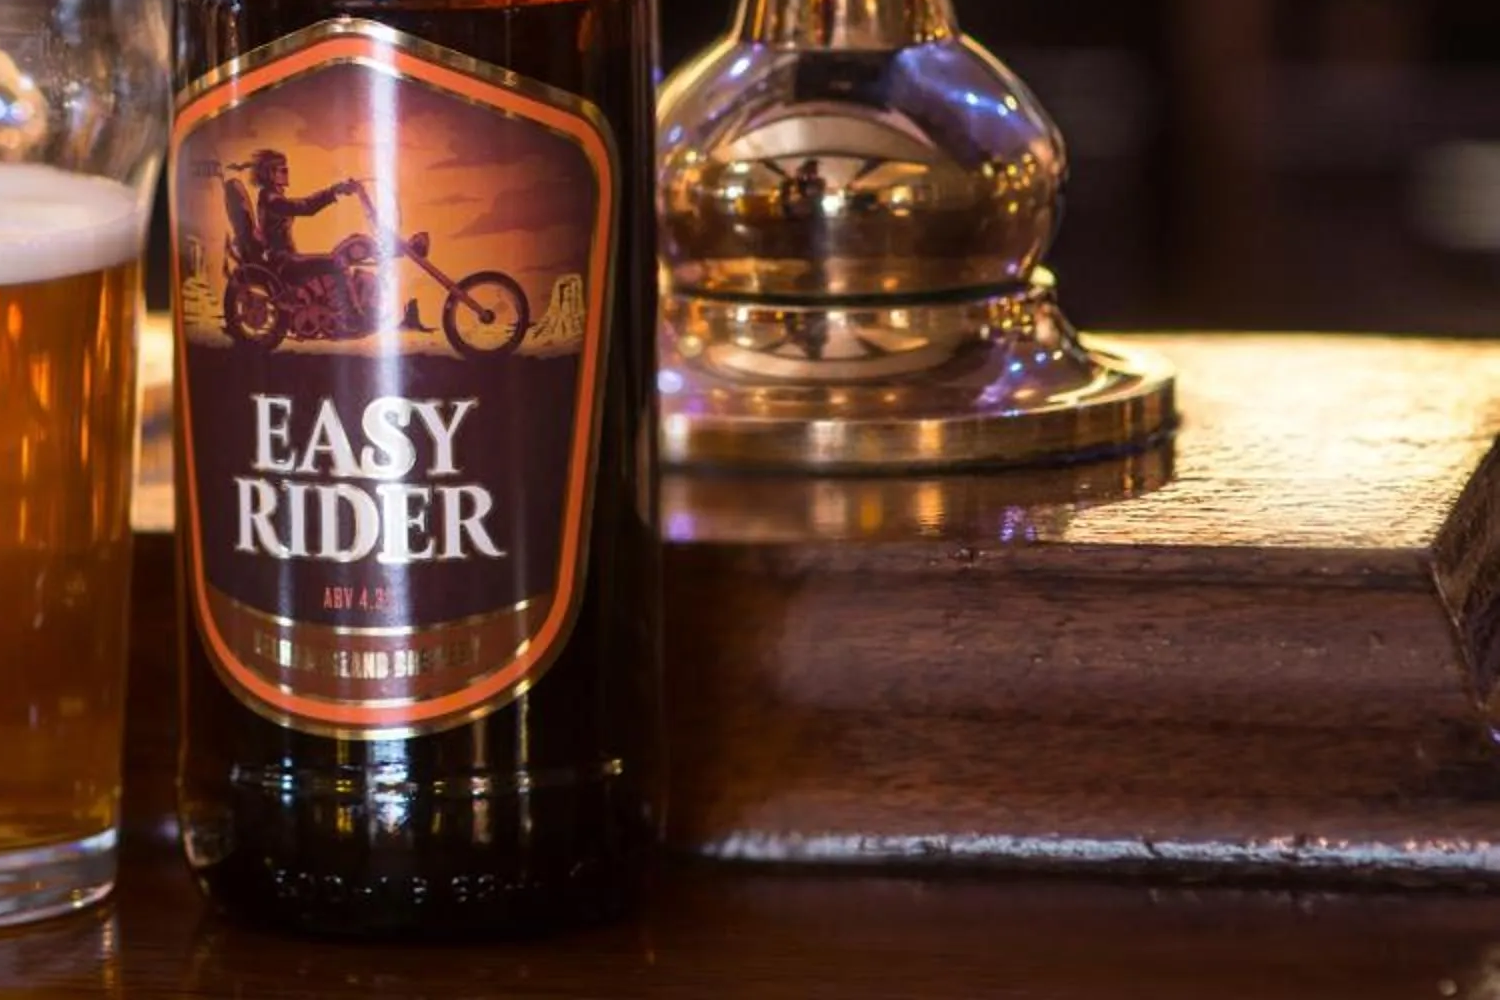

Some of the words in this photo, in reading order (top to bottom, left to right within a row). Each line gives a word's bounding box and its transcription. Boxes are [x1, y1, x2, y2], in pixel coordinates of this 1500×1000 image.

[250, 393, 478, 479] EASY
[235, 477, 506, 563] RIDER
[323, 587, 353, 609] ABV
[359, 587, 397, 612] 4.3
